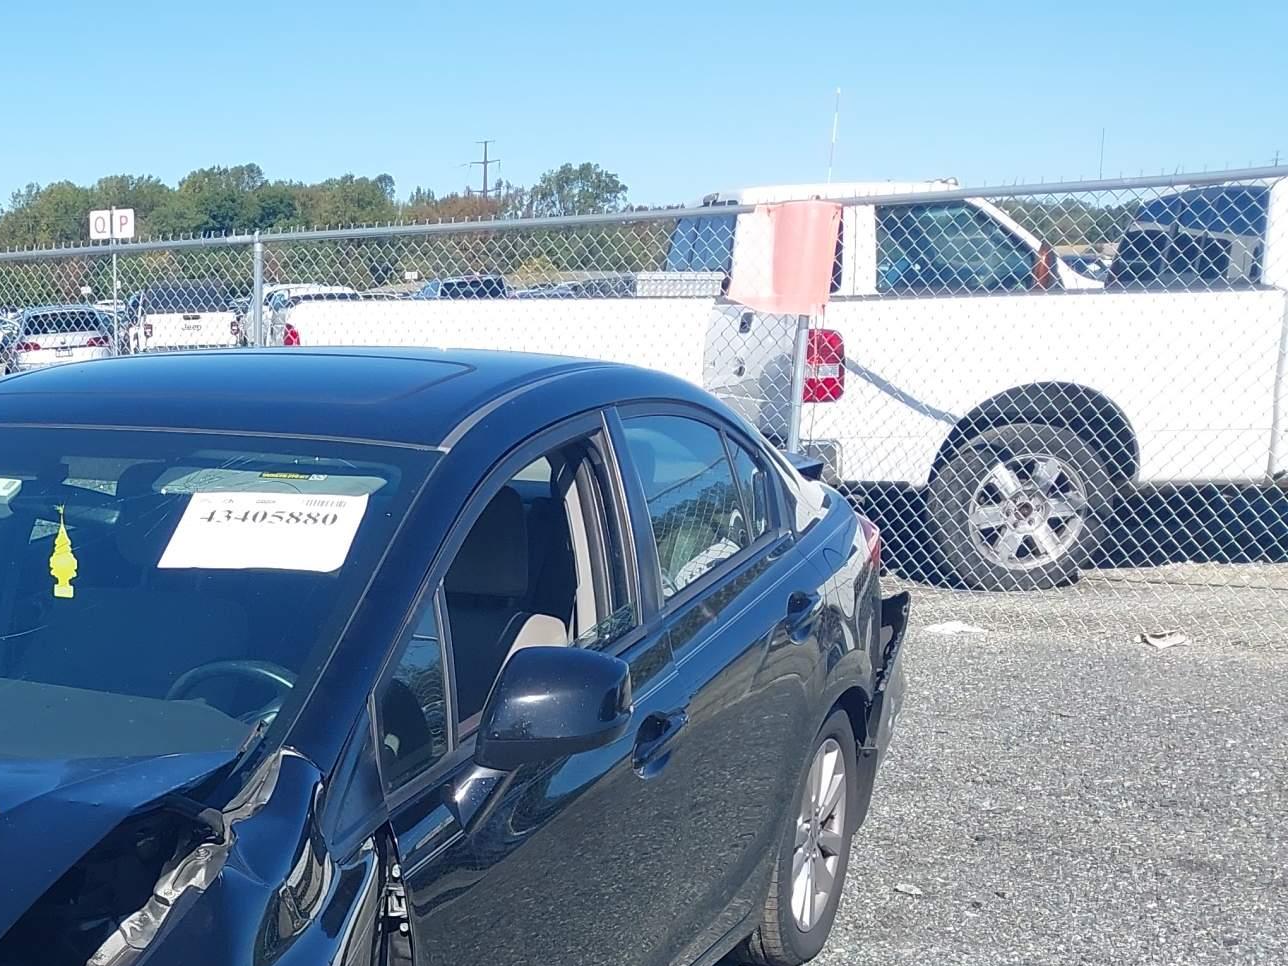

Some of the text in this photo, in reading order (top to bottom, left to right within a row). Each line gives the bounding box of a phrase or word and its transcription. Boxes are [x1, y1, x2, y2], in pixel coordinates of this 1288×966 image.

[94, 215, 107, 234] Q
[119, 215, 129, 233] P
[199, 509, 339, 526] 43405880
